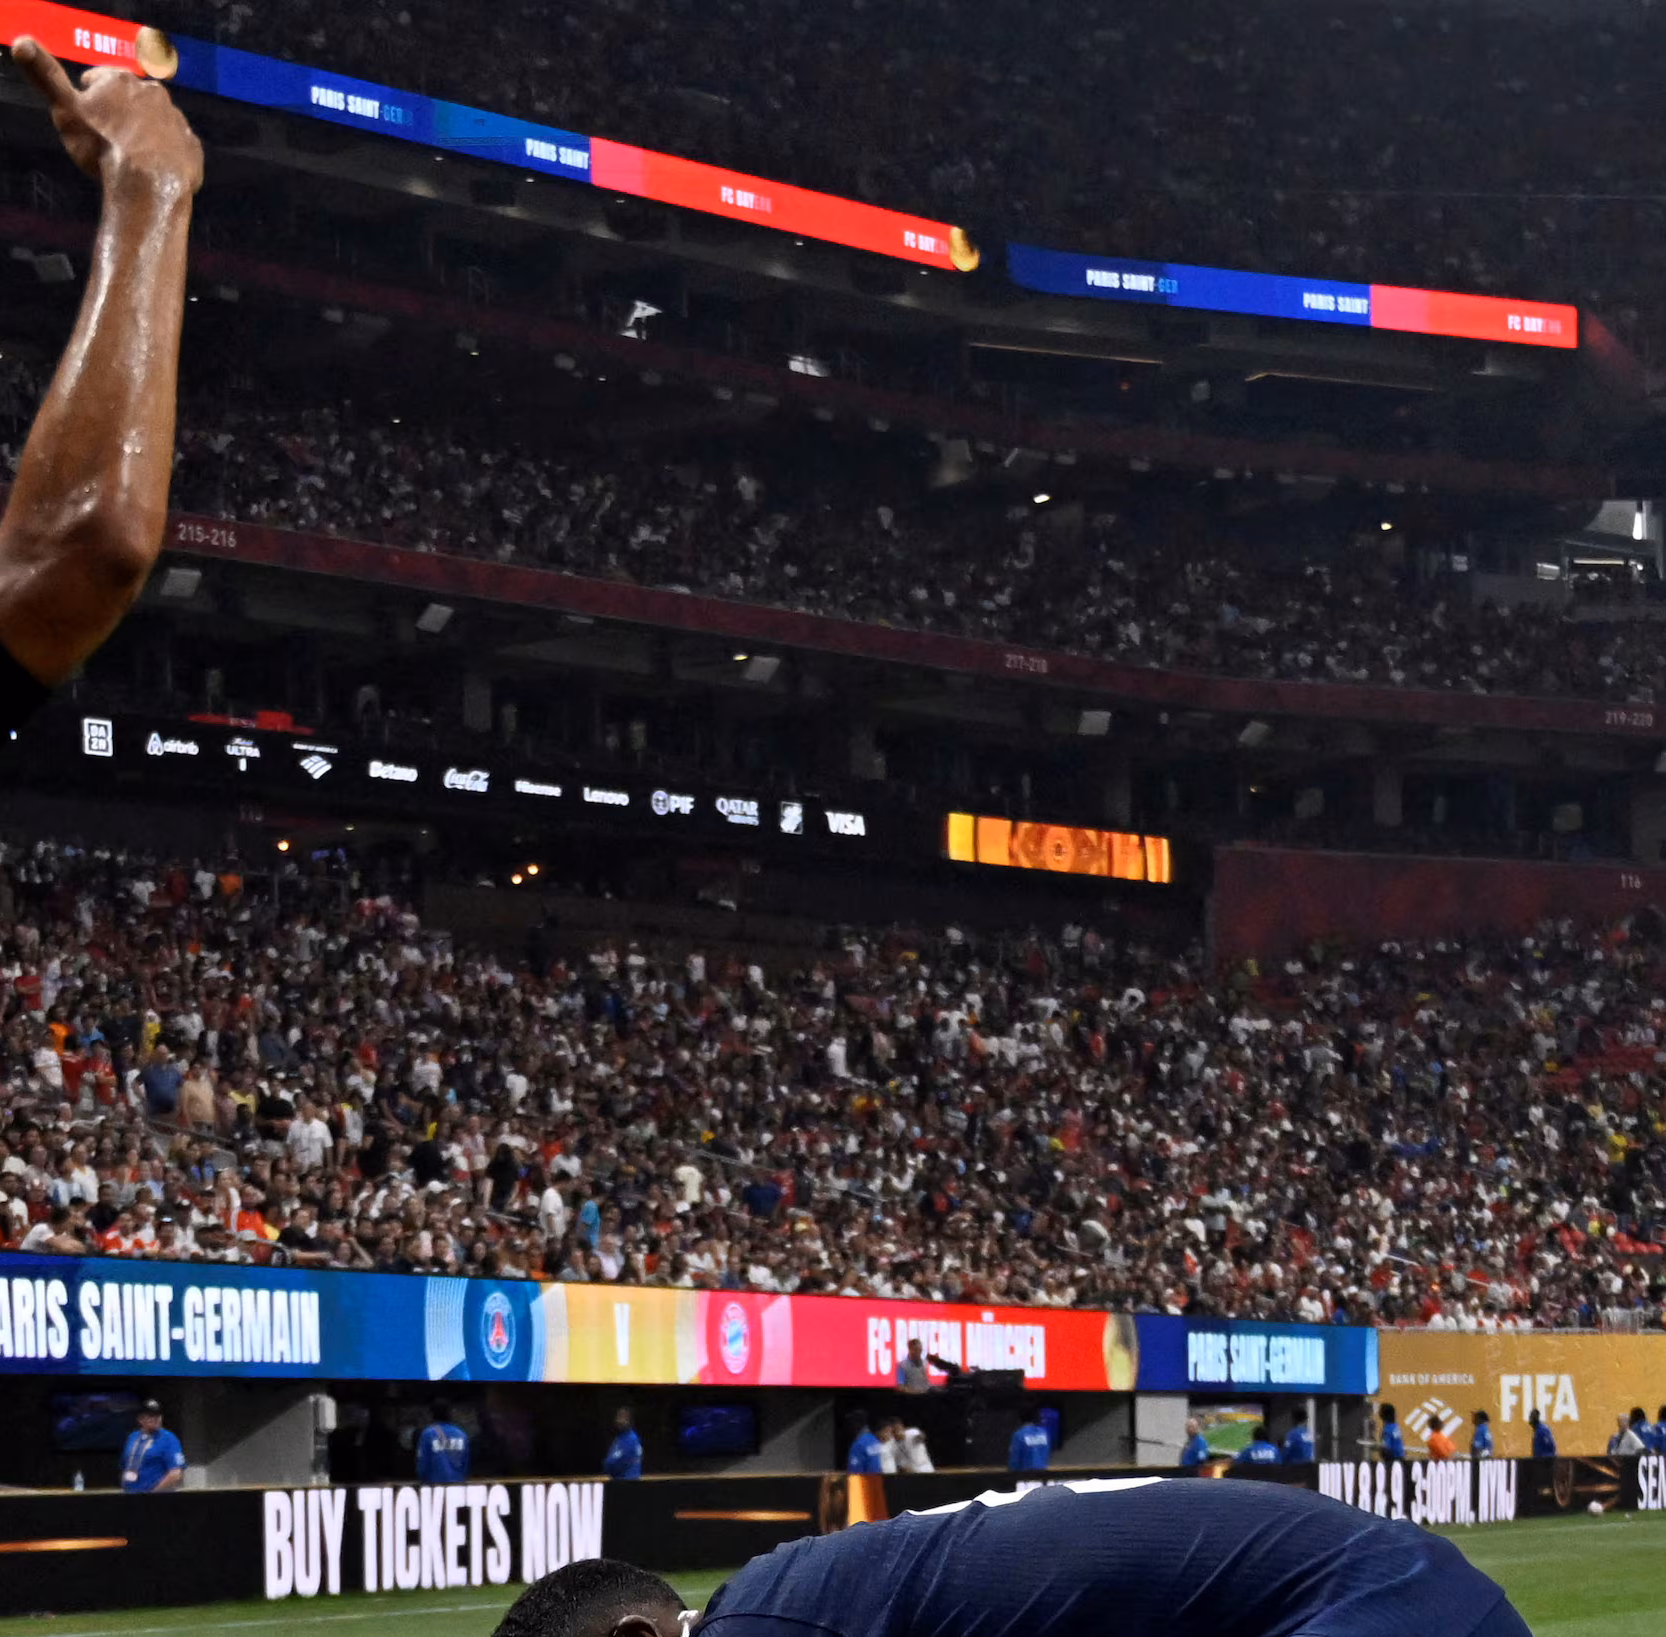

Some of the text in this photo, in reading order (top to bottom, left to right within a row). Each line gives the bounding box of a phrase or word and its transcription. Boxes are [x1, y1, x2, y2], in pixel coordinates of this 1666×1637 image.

[74, 28, 92, 49] FC
[310, 85, 346, 111] PARIS
[525, 137, 557, 163] PARIS
[721, 186, 734, 205] FC
[1086, 269, 1121, 289] PARIS
[1303, 292, 1335, 311] PARIS
[177, 522, 238, 548] 215-216
[225, 744, 261, 758] ULTRA
[584, 786, 630, 806] Lenovo
[669, 794, 695, 815] PIF
[715, 796, 759, 817] QATAR
[824, 810, 866, 837] VISA
[78, 1280, 321, 1365] SAINT-GERMAIN
[866, 1316, 892, 1376] FC
[1187, 1331, 1326, 1385] PARIS SAINT-GERMAIN
[1389, 1373, 1475, 1385] BANK OF AMERICA
[1499, 1373, 1580, 1423] FIFA
[263, 1482, 605, 1600] BUY TICKETS NOW
